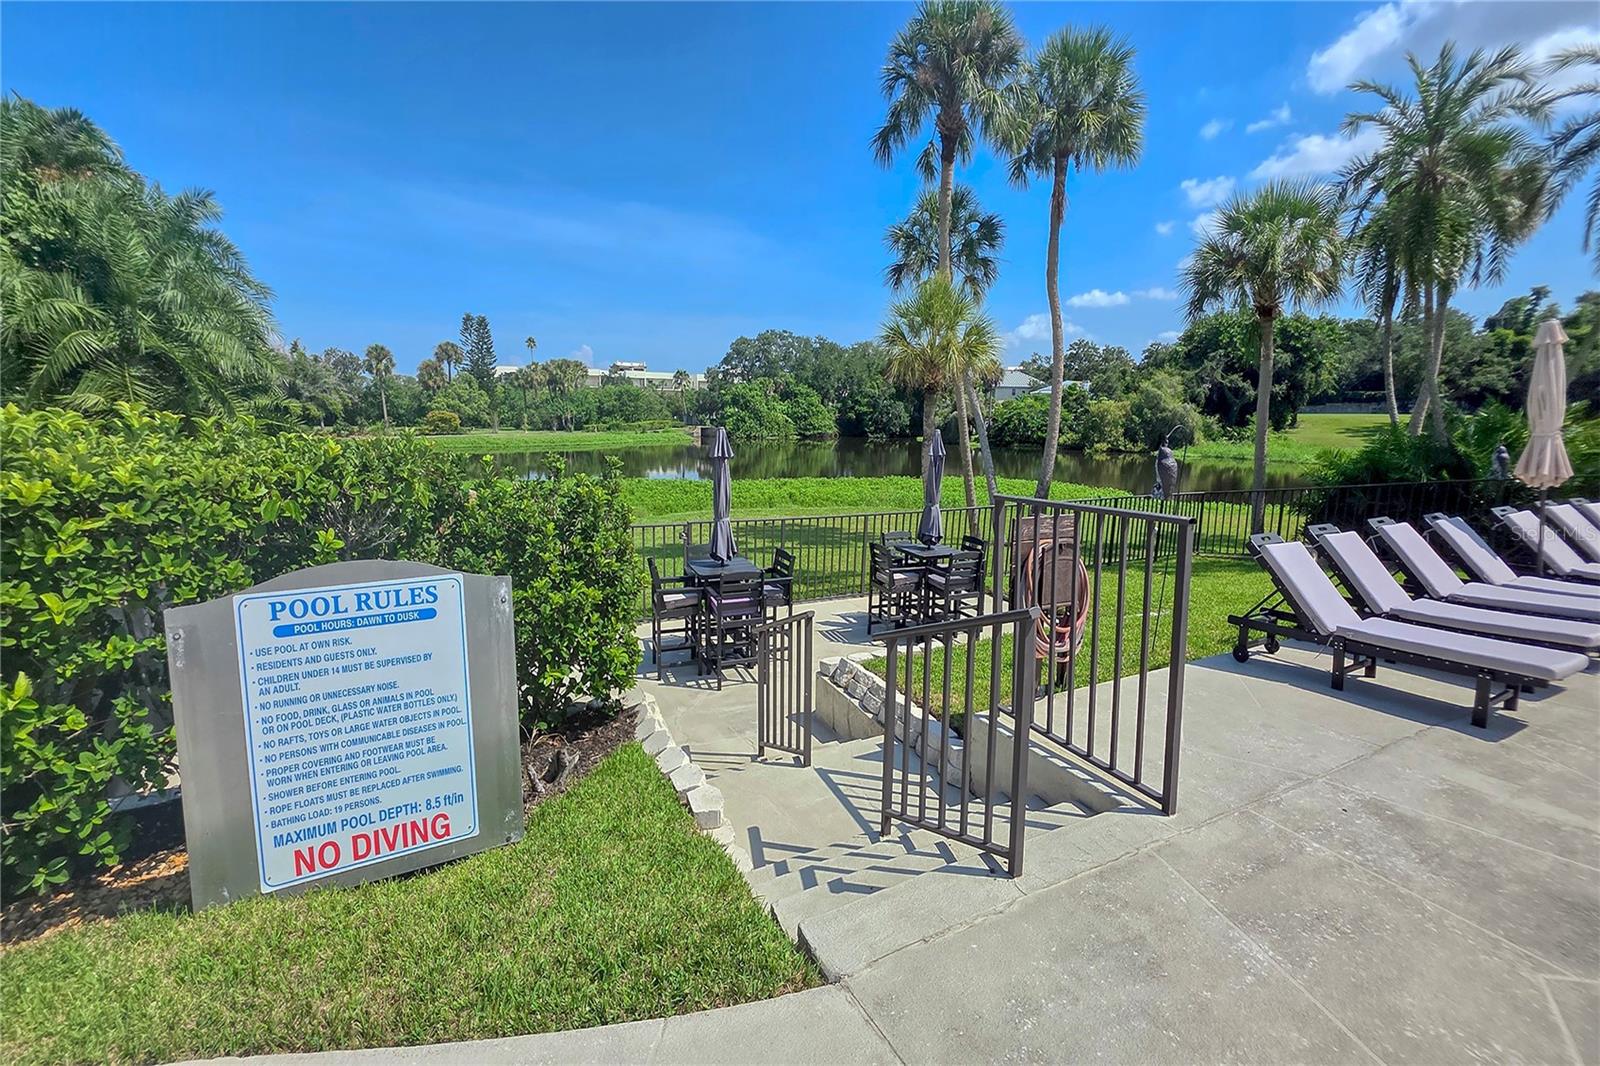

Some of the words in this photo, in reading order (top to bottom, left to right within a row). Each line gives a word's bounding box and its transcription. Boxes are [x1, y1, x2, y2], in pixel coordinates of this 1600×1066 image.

[269, 595, 348, 621] POOL
[355, 585, 438, 612] RULES
[294, 620, 319, 633] POOL
[322, 618, 354, 630] HOURS:
[357, 614, 383, 626] DAWN
[384, 614, 396, 624] TO
[397, 611, 419, 622] DUSK
[255, 647, 272, 657] USE
[274, 644, 297, 654] POOL
[300, 642, 308, 651] AT
[311, 640, 330, 650] OWN
[332, 637, 352, 646] RISK.
[256, 658, 302, 671] RESIDENTS
[305, 655, 322, 664] AND
[324, 650, 354, 662] GUESTS
[356, 648, 377, 657] ONLY.
[258, 672, 300, 686] CHILDREN
[302, 668, 329, 679] UNDER
[342, 663, 362, 672] MUST
[365, 661, 374, 670] BE
[376, 654, 421, 668] SUPERVISED
[423, 653, 432, 661] BY
[259, 687, 270, 696] AN
[273, 683, 300, 694] ADULT.
[260, 702, 271, 710] NO
[274, 696, 308, 708] RUNNING
[310, 694, 320, 702] OR
[322, 685, 375, 700] UNNECESSARY
[377, 681, 399, 691] NOISE.
[262, 716, 273, 725] NO
[276, 712, 301, 722] FOOD,
[332, 701, 358, 713] GLASS
[360, 700, 370, 708] OR
[372, 693, 404, 706] ANIMALS
[415, 688, 434, 696] POOL
[262, 726, 274, 735] OR
[277, 724, 288, 733] ON
[291, 721, 313, 731] POOL
[316, 716, 339, 726] DECK,
[341, 708, 374, 722] (PLASTIC
[376, 704, 402, 714] WATER
[404, 698, 435, 710] BOTTLES
[437, 694, 458, 704] ONLY)
[264, 740, 276, 749] NO
[278, 735, 307, 746] RAFTS,
[309, 731, 329, 740] TOYS
[331, 728, 342, 736] OR
[345, 722, 370, 734] LARGE
[372, 717, 397, 728] WATER
[400, 711, 431, 724] OBJECTS
[433, 709, 440, 717] IN
[442, 706, 462, 716] POOL.
[265, 754, 277, 763] NO
[279, 746, 318, 760] PERSONS
[320, 742, 339, 752] WITH
[341, 731, 400, 748] COMMUNICABLE
[402, 723, 437, 736] DISEASES
[438, 721, 444, 729] IN
[446, 718, 466, 728] POOL.
[266, 764, 300, 777] PROPER
[302, 755, 342, 770] COVERING
[345, 752, 360, 761] AND
[362, 742, 404, 757] FOOTWEAR
[405, 738, 424, 748] MUST
[426, 736, 436, 744] BE
[267, 776, 292, 787] WORN
[294, 770, 318, 782] WHEN
[320, 762, 358, 776] ENTERING
[360, 759, 372, 768] OR
[374, 752, 404, 765] LEAVING
[406, 748, 426, 758] POOL
[427, 744, 448, 754] AREA.
[268, 786, 304, 801] SHOWER
[306, 779, 338, 793] BEFORE
[340, 772, 377, 786] ENTERING
[380, 766, 401, 777] POOL.
[270, 803, 292, 815] ROPE
[294, 796, 324, 808] FLOATS
[326, 791, 347, 802] MUST
[350, 788, 360, 796] BE
[362, 779, 400, 794] REPLACED
[402, 773, 426, 784] AFTER
[427, 765, 463, 780] SWIMMING.
[271, 814, 306, 828] BATHING
[308, 808, 332, 820] LOAD:
[334, 805, 343, 814] 19
[344, 796, 382, 811] PERSONS.
[274, 821, 337, 848] MAXIMUM
[341, 813, 376, 831] POOL
[379, 802, 422, 822] DEPTH:
[425, 797, 440, 812] 8.5
[444, 792, 464, 806] ft/in
[293, 841, 340, 876] NO
[352, 812, 451, 861] DIVING
